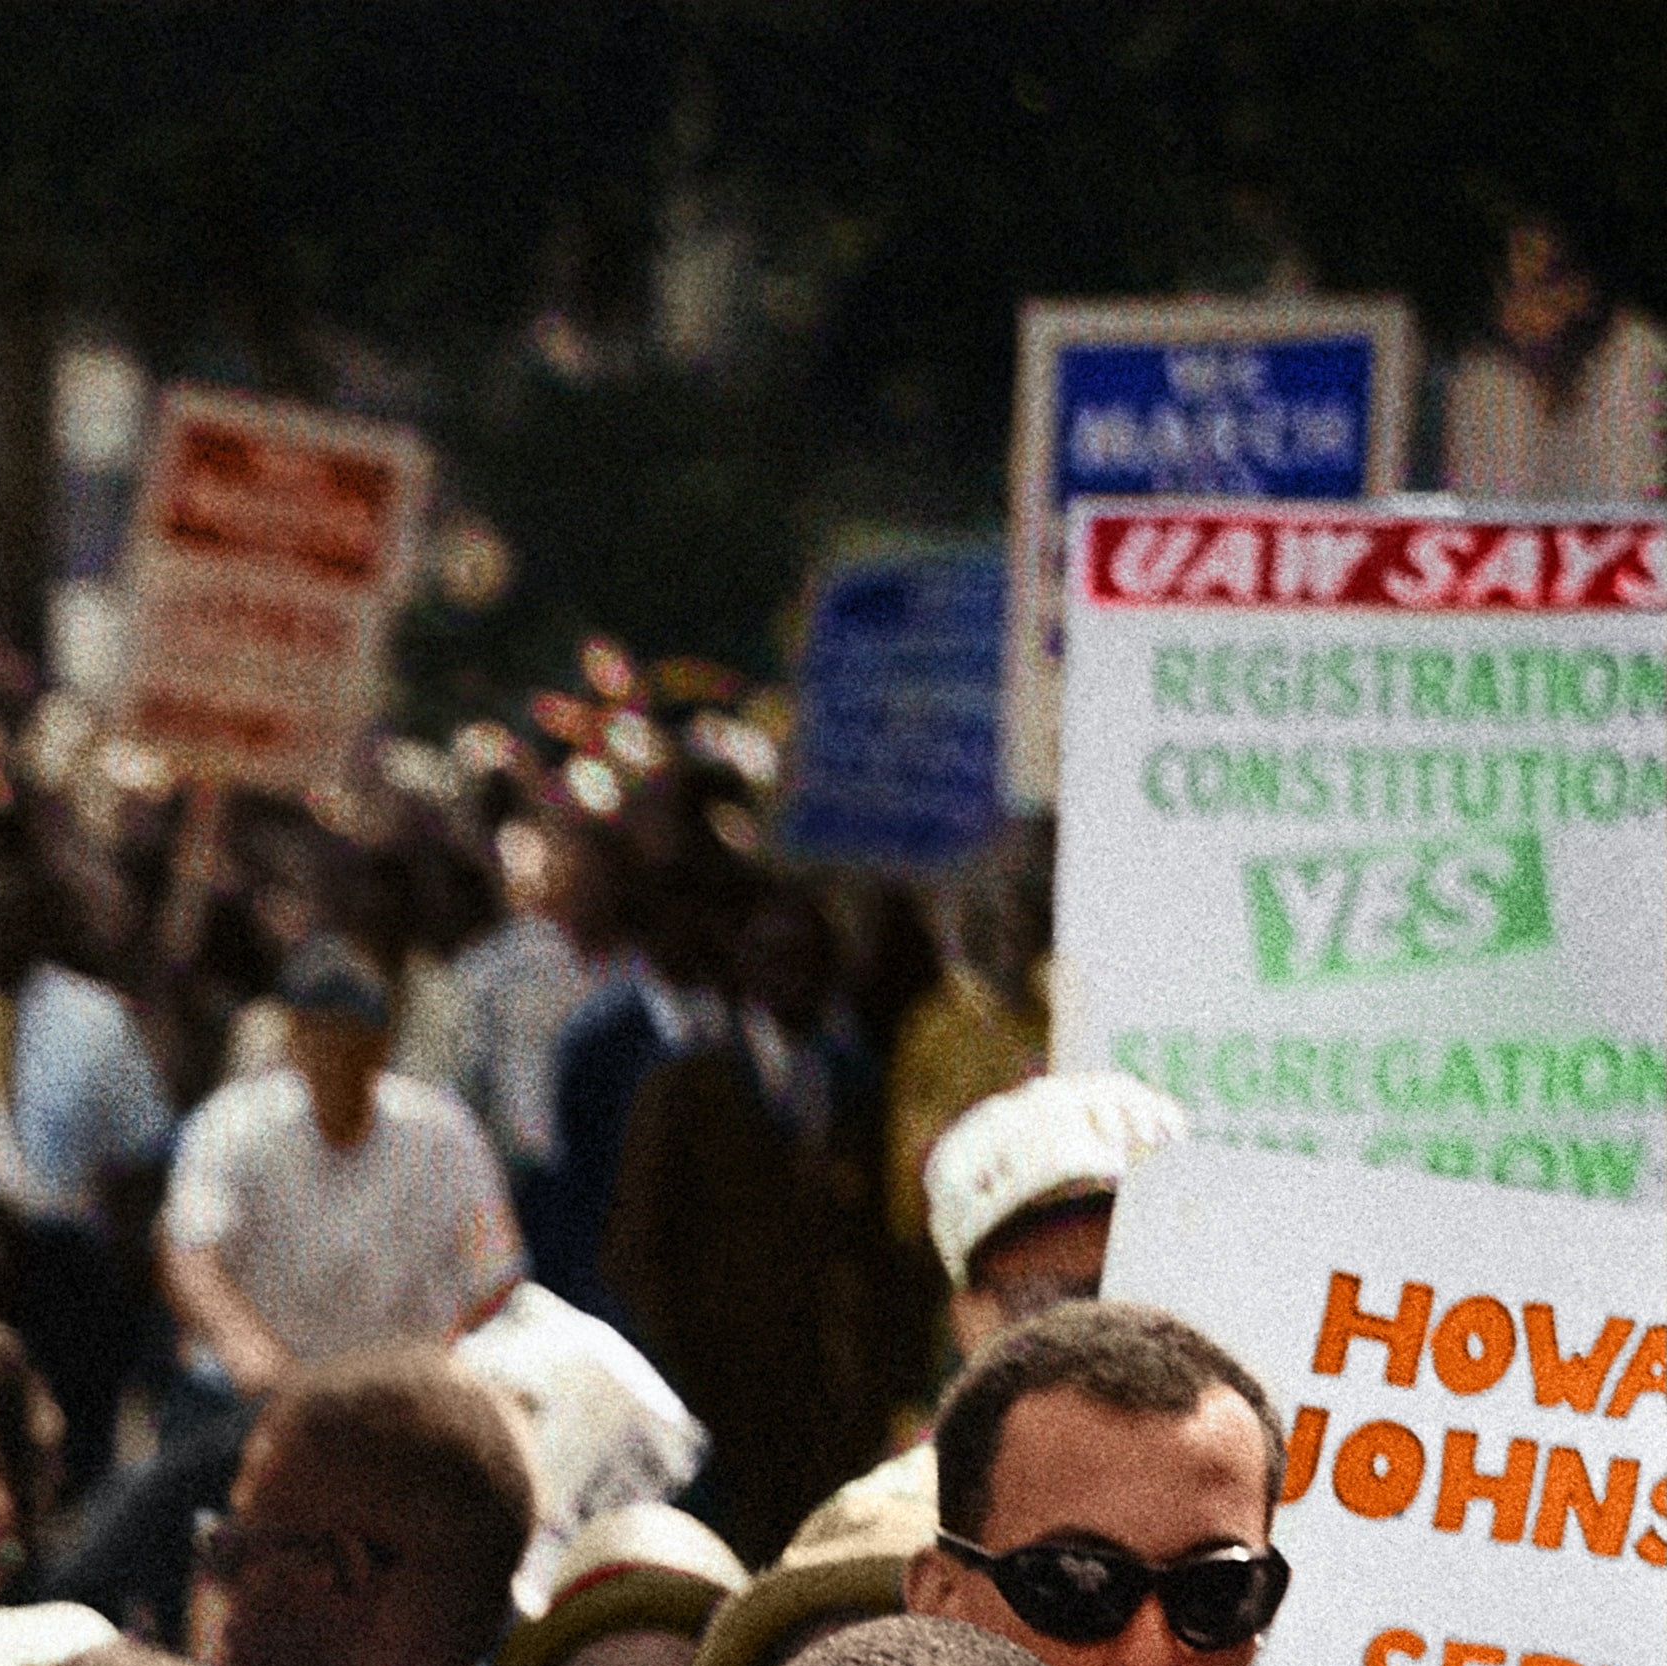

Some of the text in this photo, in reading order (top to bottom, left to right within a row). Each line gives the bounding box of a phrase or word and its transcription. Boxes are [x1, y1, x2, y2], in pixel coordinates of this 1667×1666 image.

[1107, 525, 1370, 603] UAW
[1273, 848, 1514, 976] YES
[1312, 1270, 1667, 1419] HOWA
